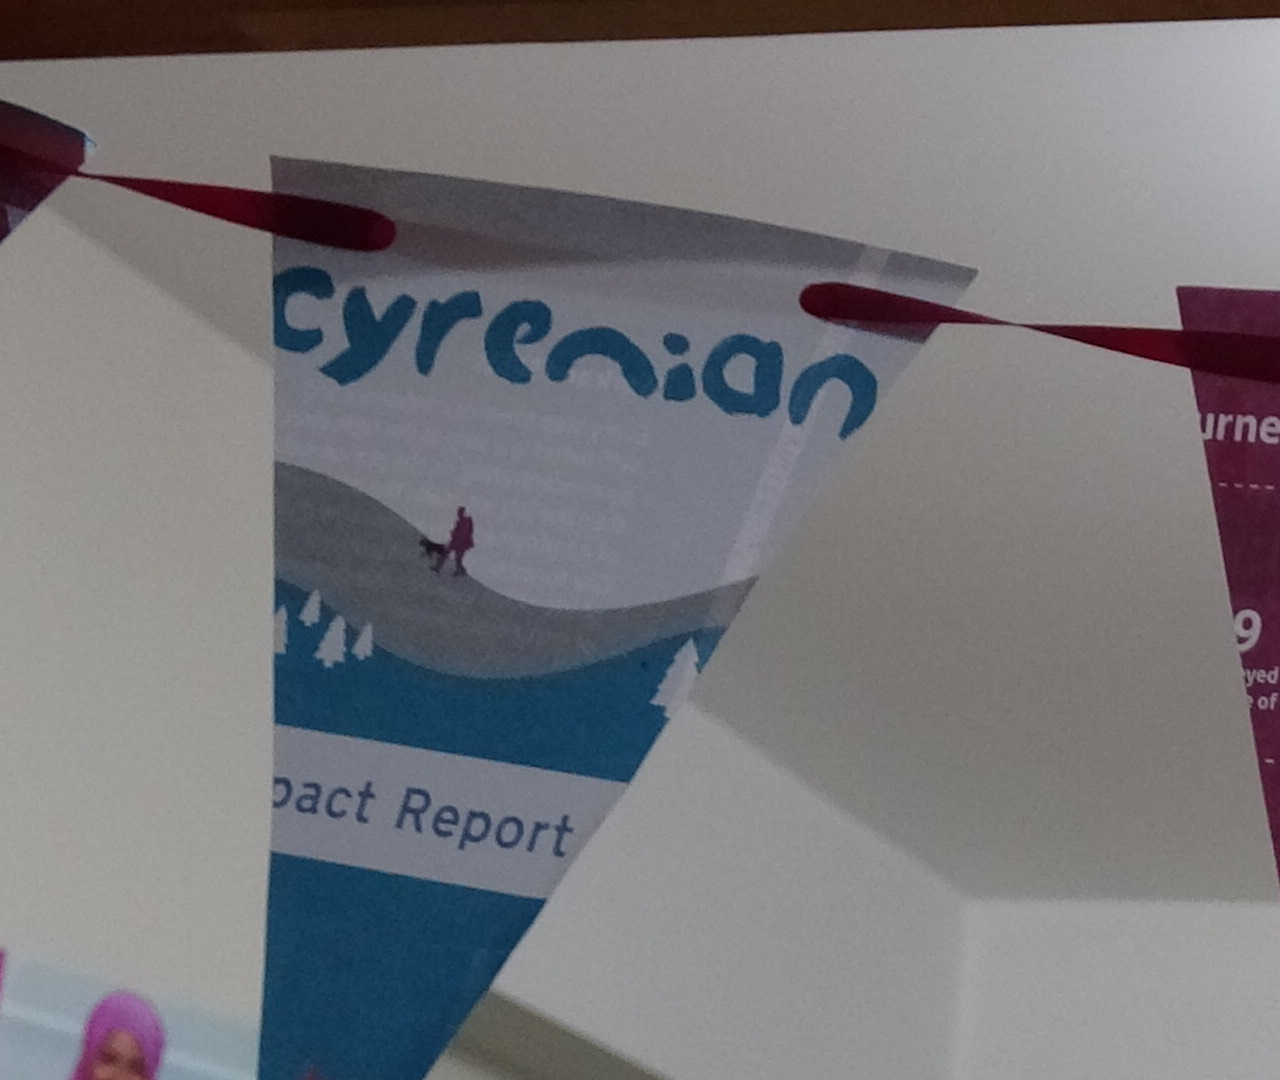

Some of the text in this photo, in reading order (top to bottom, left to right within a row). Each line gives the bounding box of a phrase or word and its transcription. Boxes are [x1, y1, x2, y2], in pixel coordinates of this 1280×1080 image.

[271, 266, 878, 441] cyrenian
[1258, 693, 1279, 711] of
[395, 786, 574, 857] Report
